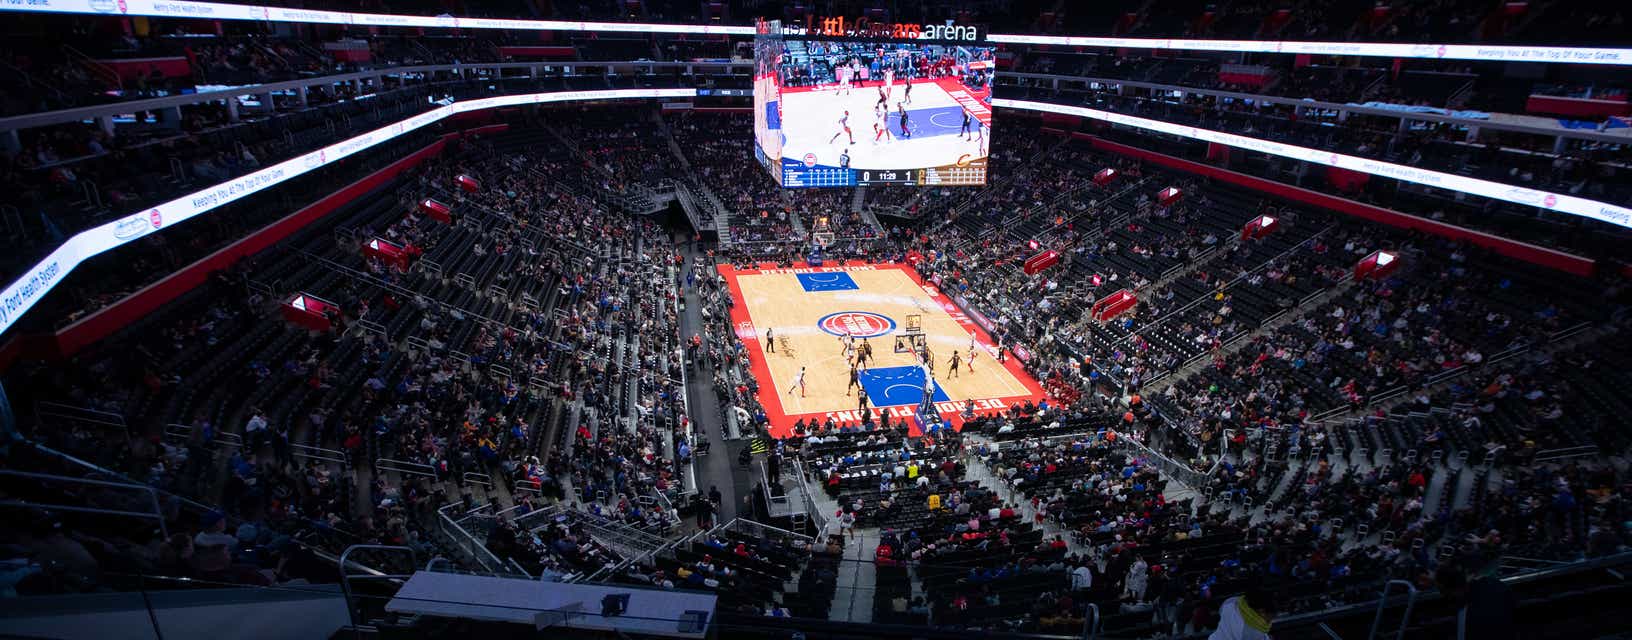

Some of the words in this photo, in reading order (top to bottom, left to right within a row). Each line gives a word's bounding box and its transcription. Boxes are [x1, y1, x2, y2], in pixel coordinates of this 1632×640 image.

[806, 14, 853, 37] Little
[855, 16, 921, 39] Caesars
[925, 25, 977, 41] arena
[863, 171, 870, 182] 0
[879, 172, 897, 180] 11:29
[906, 171, 911, 181] 1
[5, 290, 22, 314] Ford
[20, 277, 41, 300] Health
[39, 262, 59, 286] System
